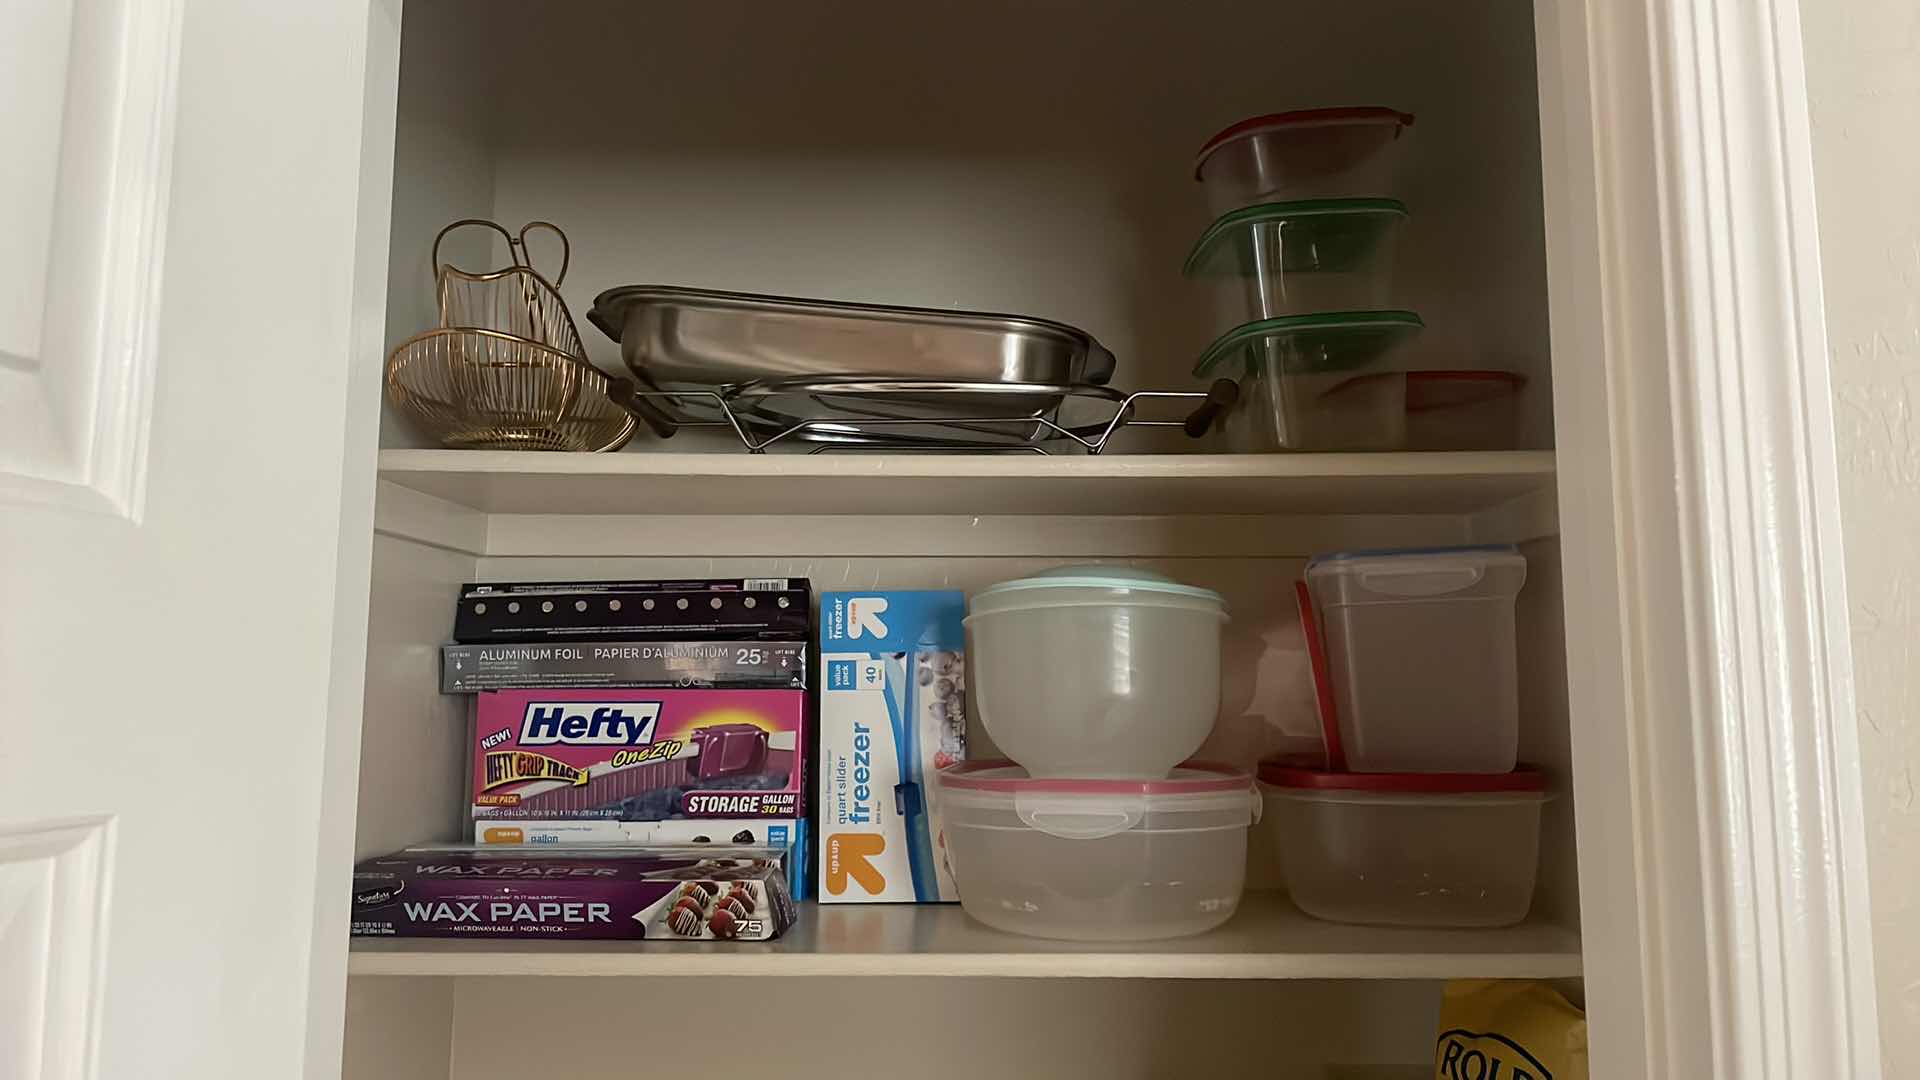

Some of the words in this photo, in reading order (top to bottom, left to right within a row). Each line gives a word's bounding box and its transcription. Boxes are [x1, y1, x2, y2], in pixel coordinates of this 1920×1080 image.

[833, 597, 843, 640] freezer
[479, 649, 551, 661] ALUMINUM
[555, 649, 583, 660] FOIL
[594, 648, 639, 660] PAPIER
[643, 646, 729, 659] D'ALUMINIUM
[736, 649, 762, 665] 25
[842, 664, 850, 686] pack
[865, 667, 876, 684] 40
[528, 707, 652, 745] Hefty
[481, 728, 512, 749] NEW!
[486, 753, 513, 784] HEFTY
[515, 753, 544, 777] GRIP
[546, 759, 580, 780] TRACK
[836, 756, 846, 789] slider
[849, 721, 870, 824] freezer
[477, 795, 497, 805] VALUE
[499, 795, 517, 805] PACK
[688, 796, 760, 813] STORAGE
[762, 794, 795, 805] GALLON
[837, 792, 847, 824] quart
[761, 805, 778, 814] 30
[778, 806, 794, 814] BAGS
[530, 833, 560, 844] gallon
[415, 865, 489, 874] WAX
[497, 866, 619, 876] PAPER
[403, 902, 482, 922] WAX
[490, 902, 613, 922] PAPER
[453, 925, 515, 933] MICROWAVEABLE
[520, 925, 564, 933] NON-STICK
[734, 920, 762, 932] 75
